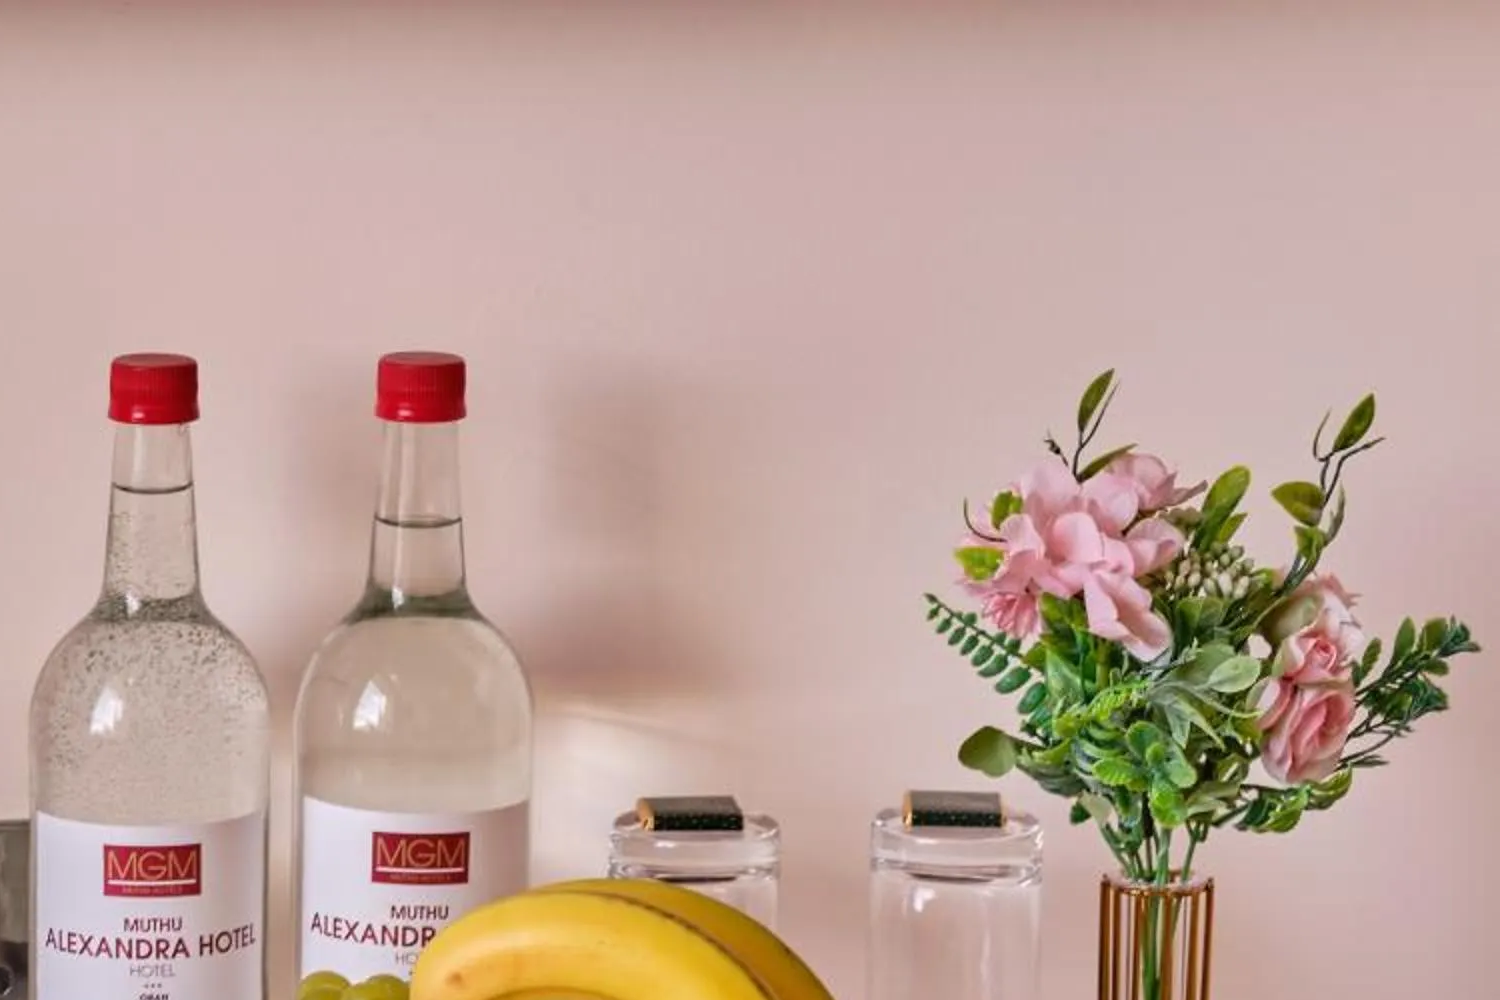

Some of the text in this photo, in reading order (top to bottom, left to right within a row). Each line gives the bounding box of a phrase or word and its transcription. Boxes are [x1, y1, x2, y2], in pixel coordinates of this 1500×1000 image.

[106, 850, 198, 881] MGM
[375, 835, 465, 868] MGM
[123, 917, 183, 933] MUTHU
[390, 905, 449, 920] MUTHU
[45, 923, 257, 960] ALEXANDRA HOTEL
[310, 912, 437, 948] ALEXANDR
[129, 964, 176, 978] HOTEL
